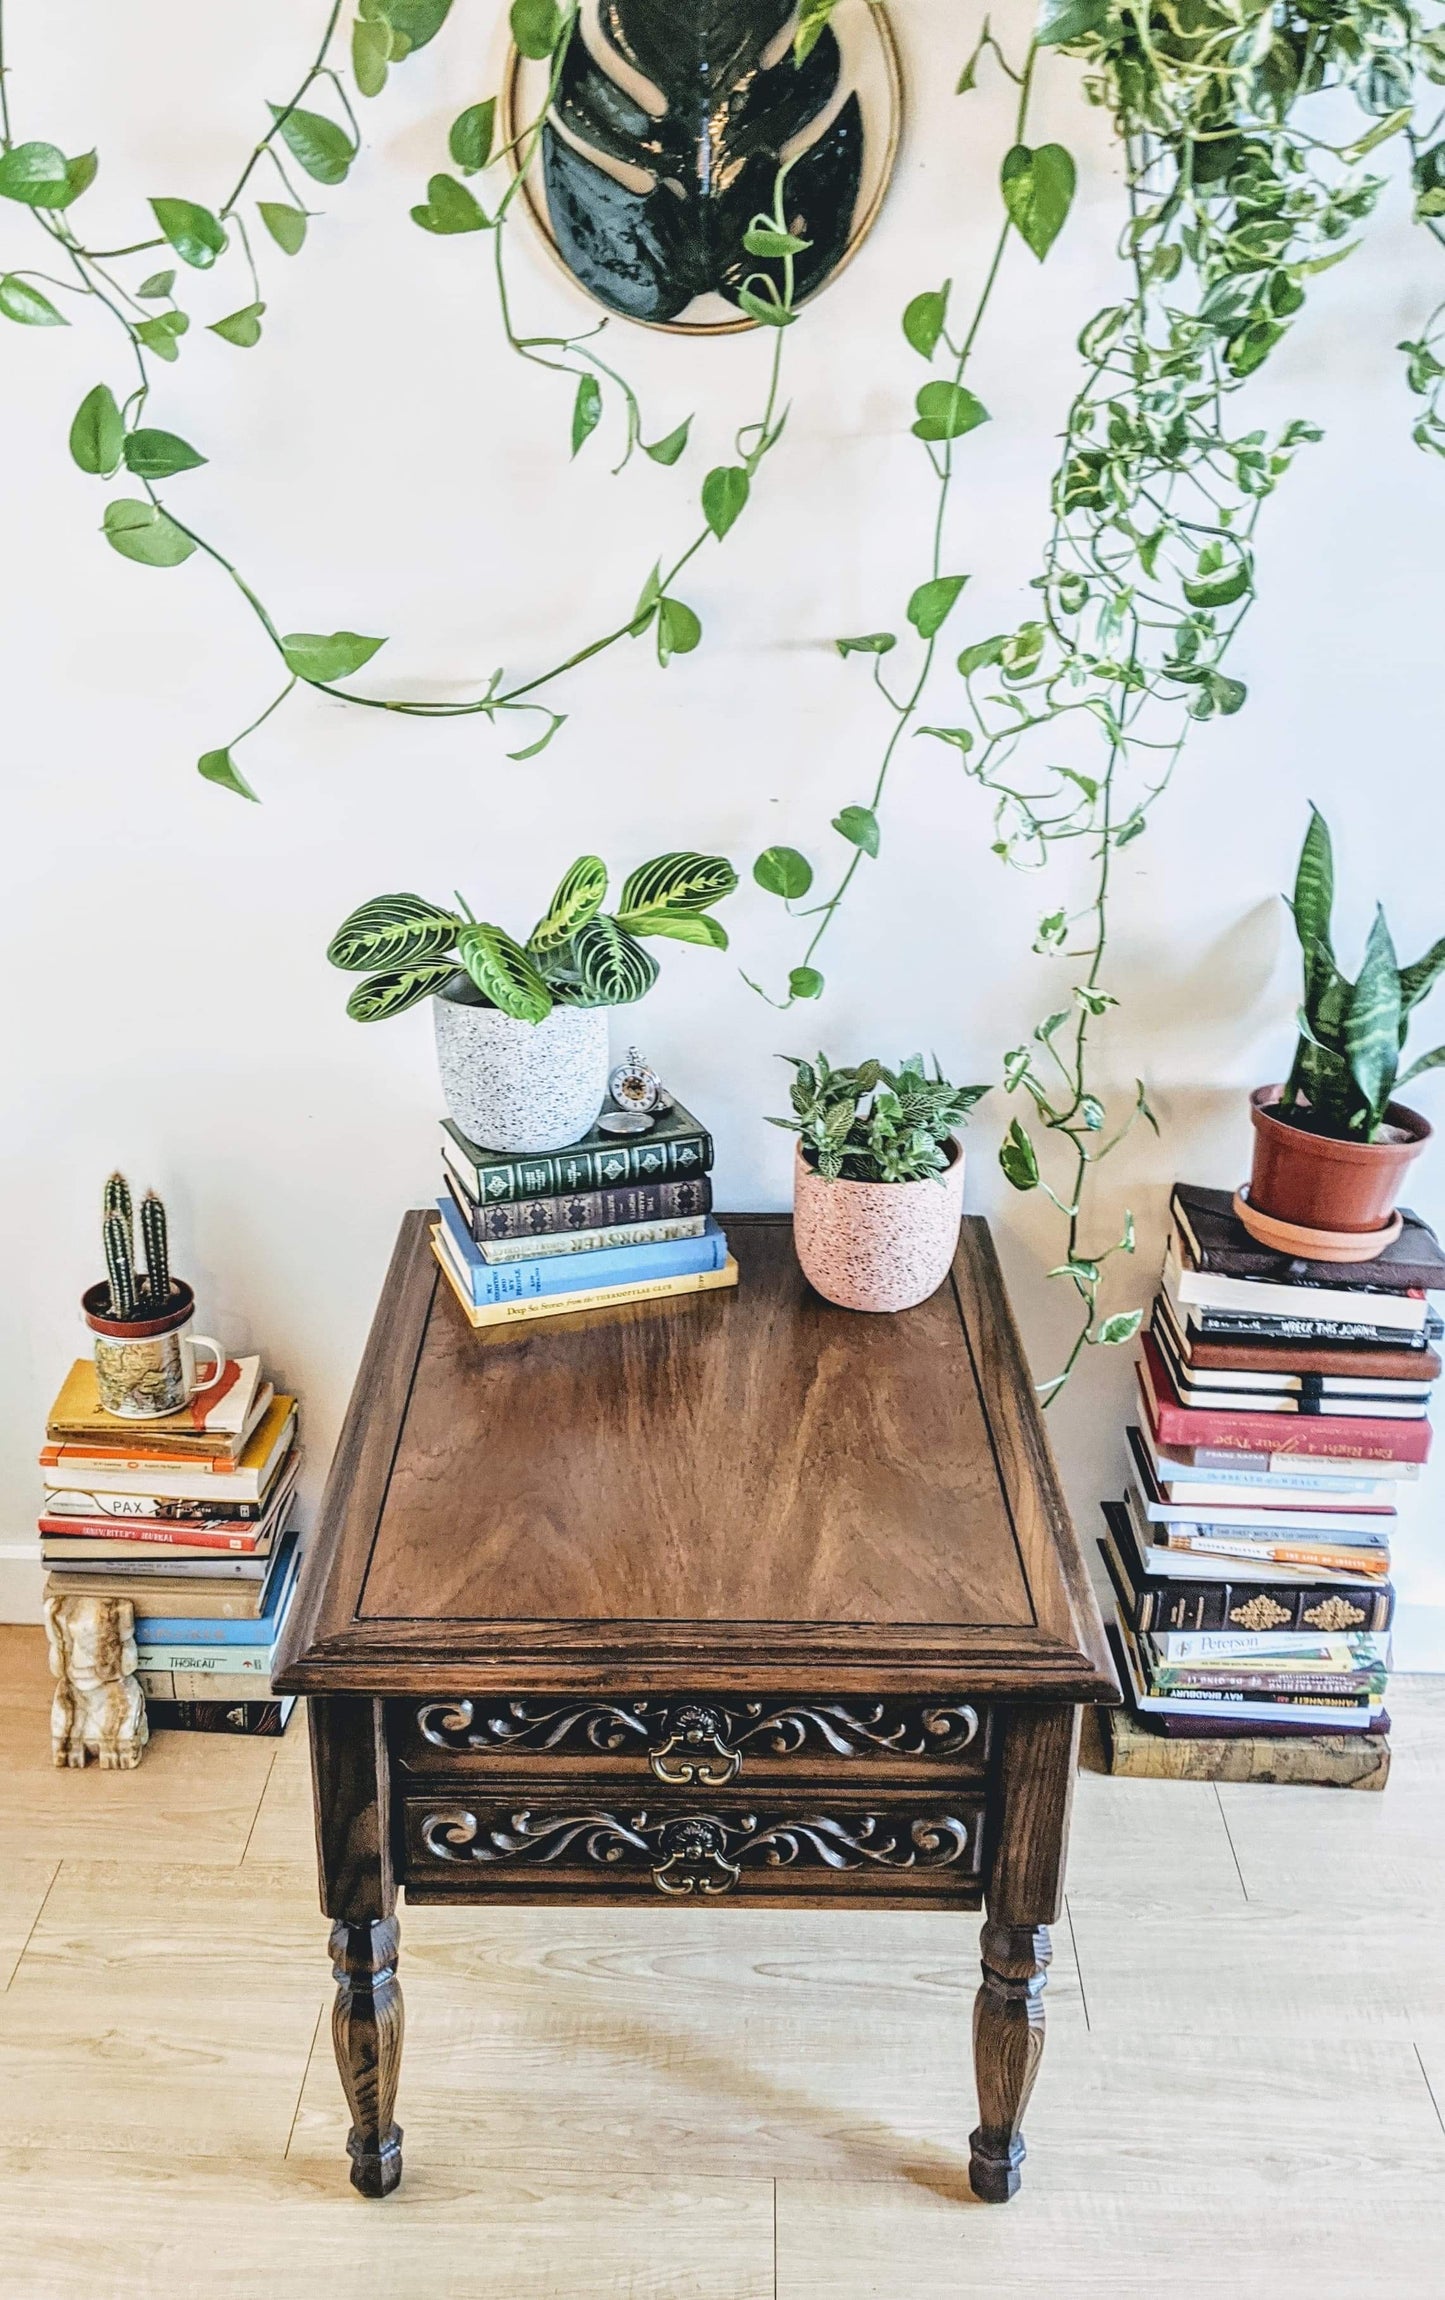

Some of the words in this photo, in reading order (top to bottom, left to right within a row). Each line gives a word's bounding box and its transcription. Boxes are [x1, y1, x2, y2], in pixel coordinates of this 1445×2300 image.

[646, 1196, 655, 1212] THE
[570, 1230, 657, 1252] FORSTER
[493, 1270, 501, 1301] COUNTRY
[507, 1306, 526, 1316] Deep
[541, 1301, 564, 1310] Stories
[1280, 1320, 1314, 1335] WRECK
[1315, 1321, 1339, 1336] THIS
[1338, 1323, 1379, 1337] JOURNAL
[1213, 1434, 1252, 1450] Type
[1308, 1442, 1318, 1453] 4
[1323, 1443, 1363, 1458] Right
[1367, 1446, 1393, 1460] Eat
[113, 1501, 143, 1514] PAX
[140, 1530, 174, 1543] JOURNAL
[1200, 1636, 1259, 1651] Peterson
[168, 1657, 228, 1669] THOREAU
[1170, 1689, 1222, 1700] BRADBURY
[1222, 1692, 1244, 1702] RAY
[1291, 1696, 1359, 1707] FAHRENHEIT
